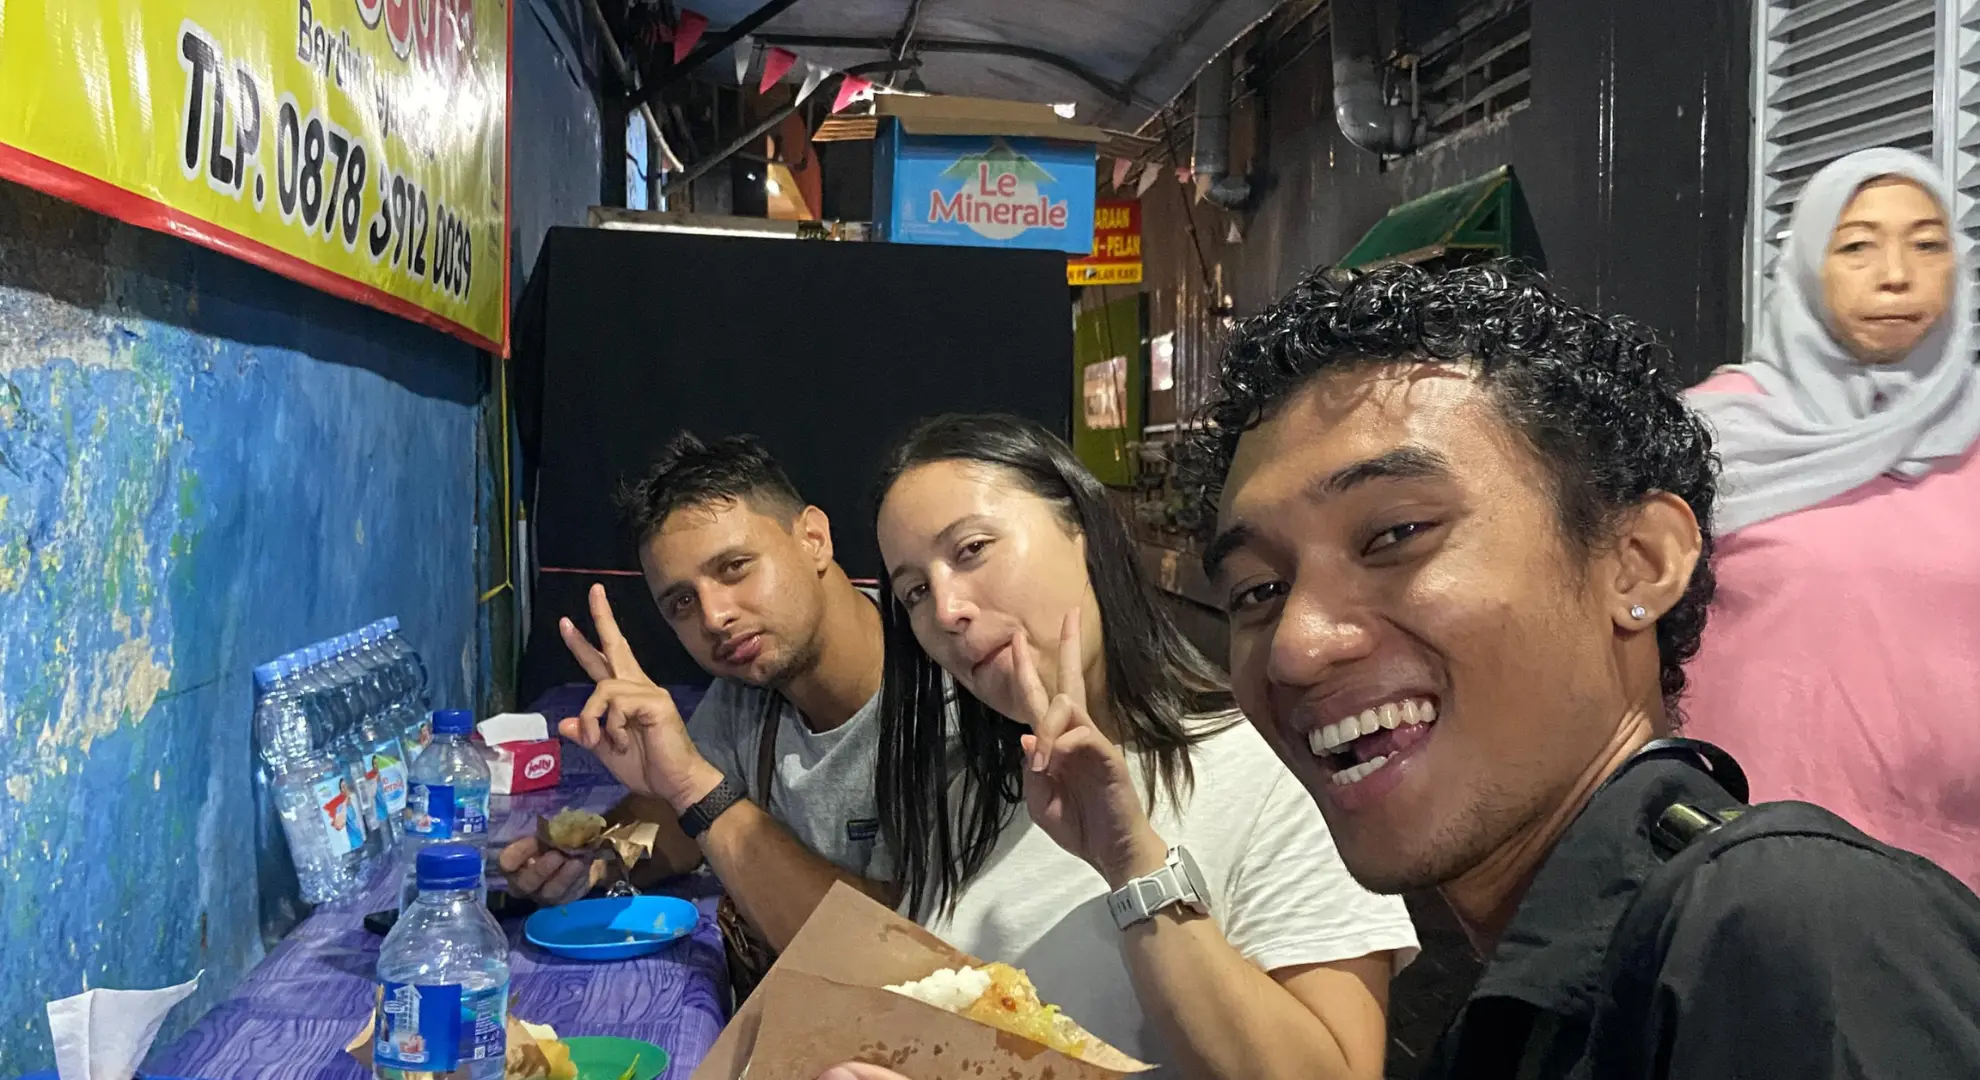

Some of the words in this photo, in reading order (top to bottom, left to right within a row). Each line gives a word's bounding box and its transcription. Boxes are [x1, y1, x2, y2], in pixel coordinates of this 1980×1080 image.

[183, 32, 264, 201] TLP.
[278, 102, 366, 245] 0878
[370, 161, 429, 276] 3912
[433, 204, 472, 300] 0039
[979, 163, 1018, 197] Le
[929, 191, 1066, 228] Minerale
